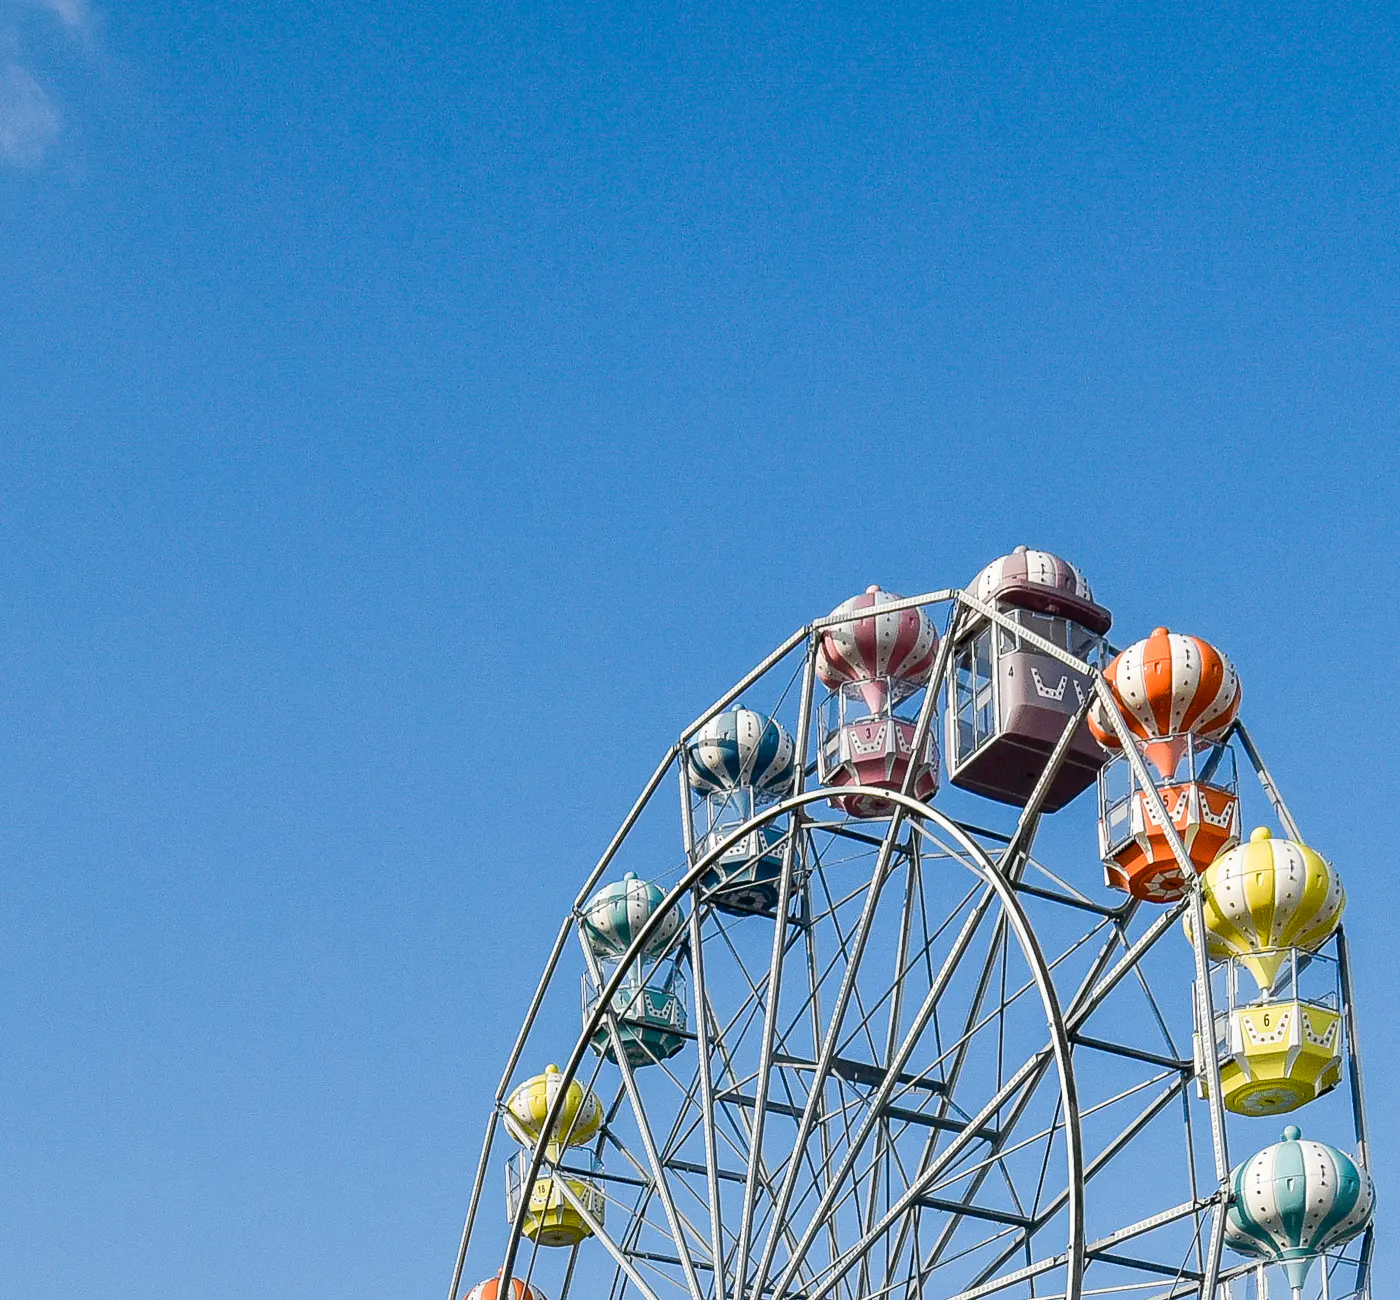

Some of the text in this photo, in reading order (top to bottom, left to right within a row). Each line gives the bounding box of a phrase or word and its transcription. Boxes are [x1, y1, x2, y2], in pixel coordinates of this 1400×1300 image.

[1008, 665, 1013, 678] 4
[865, 728, 872, 739] 3
[1163, 795, 1169, 807] 5
[1263, 1013, 1270, 1027] 6
[537, 1184, 546, 1194] 18
